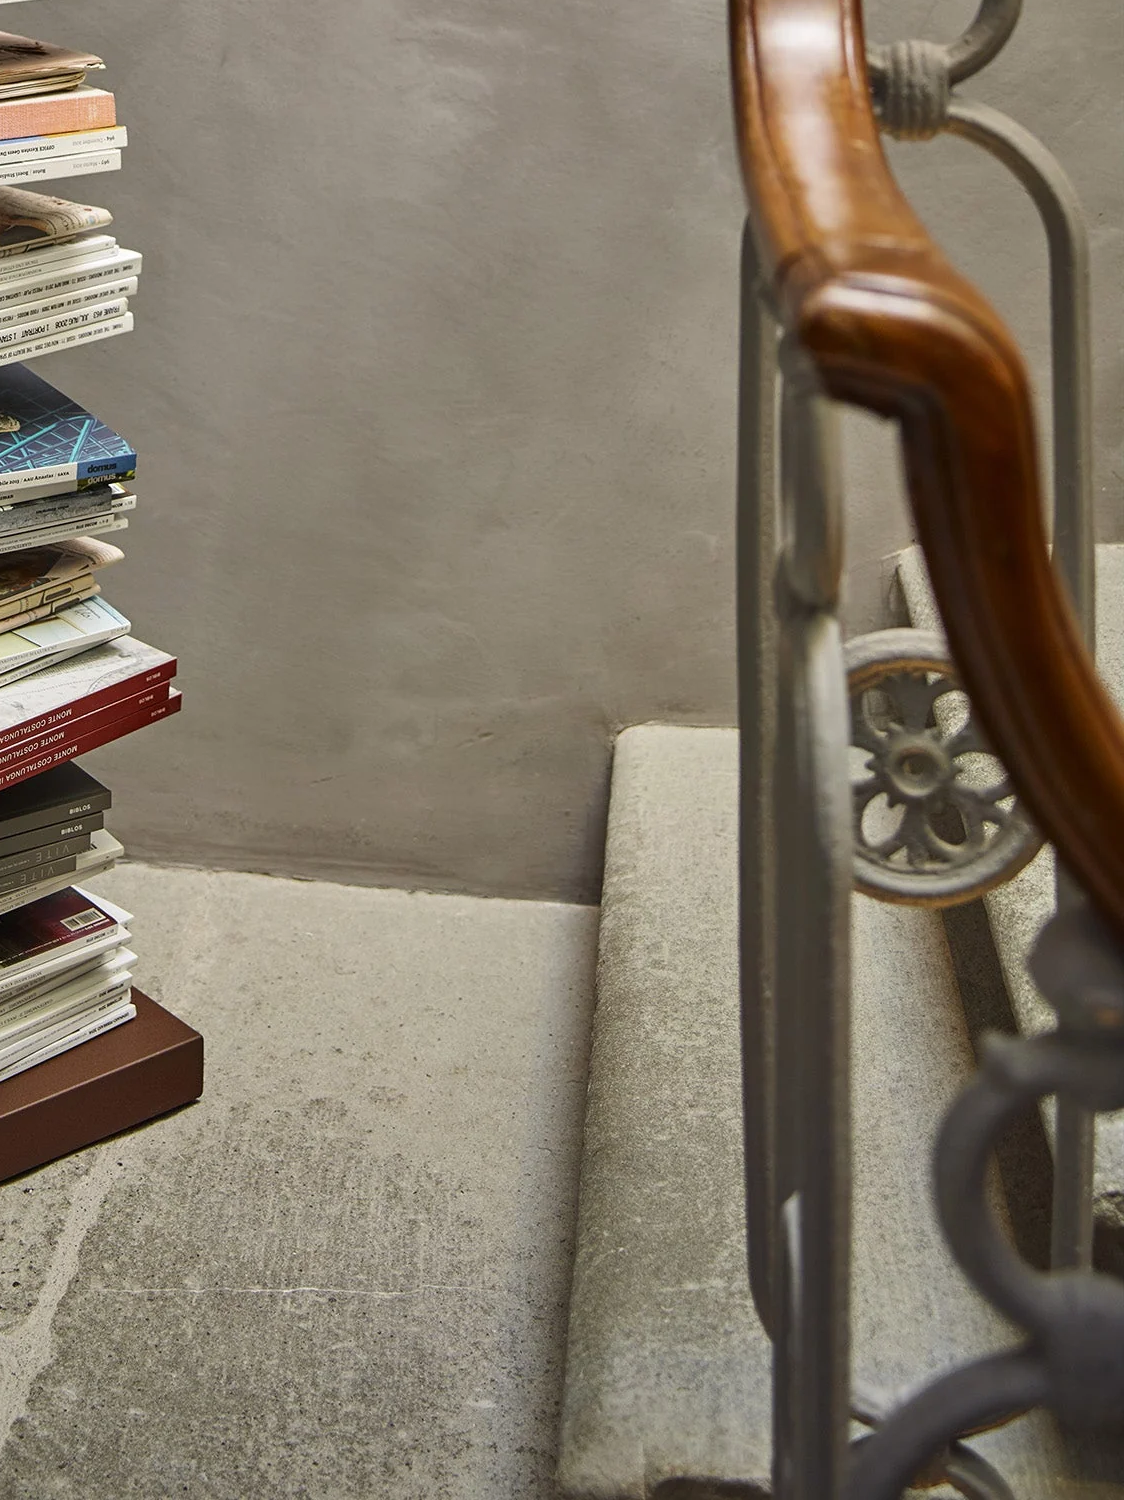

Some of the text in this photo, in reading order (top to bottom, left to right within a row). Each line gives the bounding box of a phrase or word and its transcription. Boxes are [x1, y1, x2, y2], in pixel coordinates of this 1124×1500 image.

[21, 324, 45, 338] PORTRAIT
[87, 461, 117, 474] domus
[87, 472, 117, 484] domus
[47, 707, 71, 725] MONTE
[0, 718, 46, 745] COSTALUNGA
[40, 730, 64, 749] MONTE
[53, 744, 77, 762] MONTE
[5, 755, 51, 783] COSTALUNGA
[69, 803, 91, 815] BIBLOS
[61, 824, 83, 835] BIBLOS
